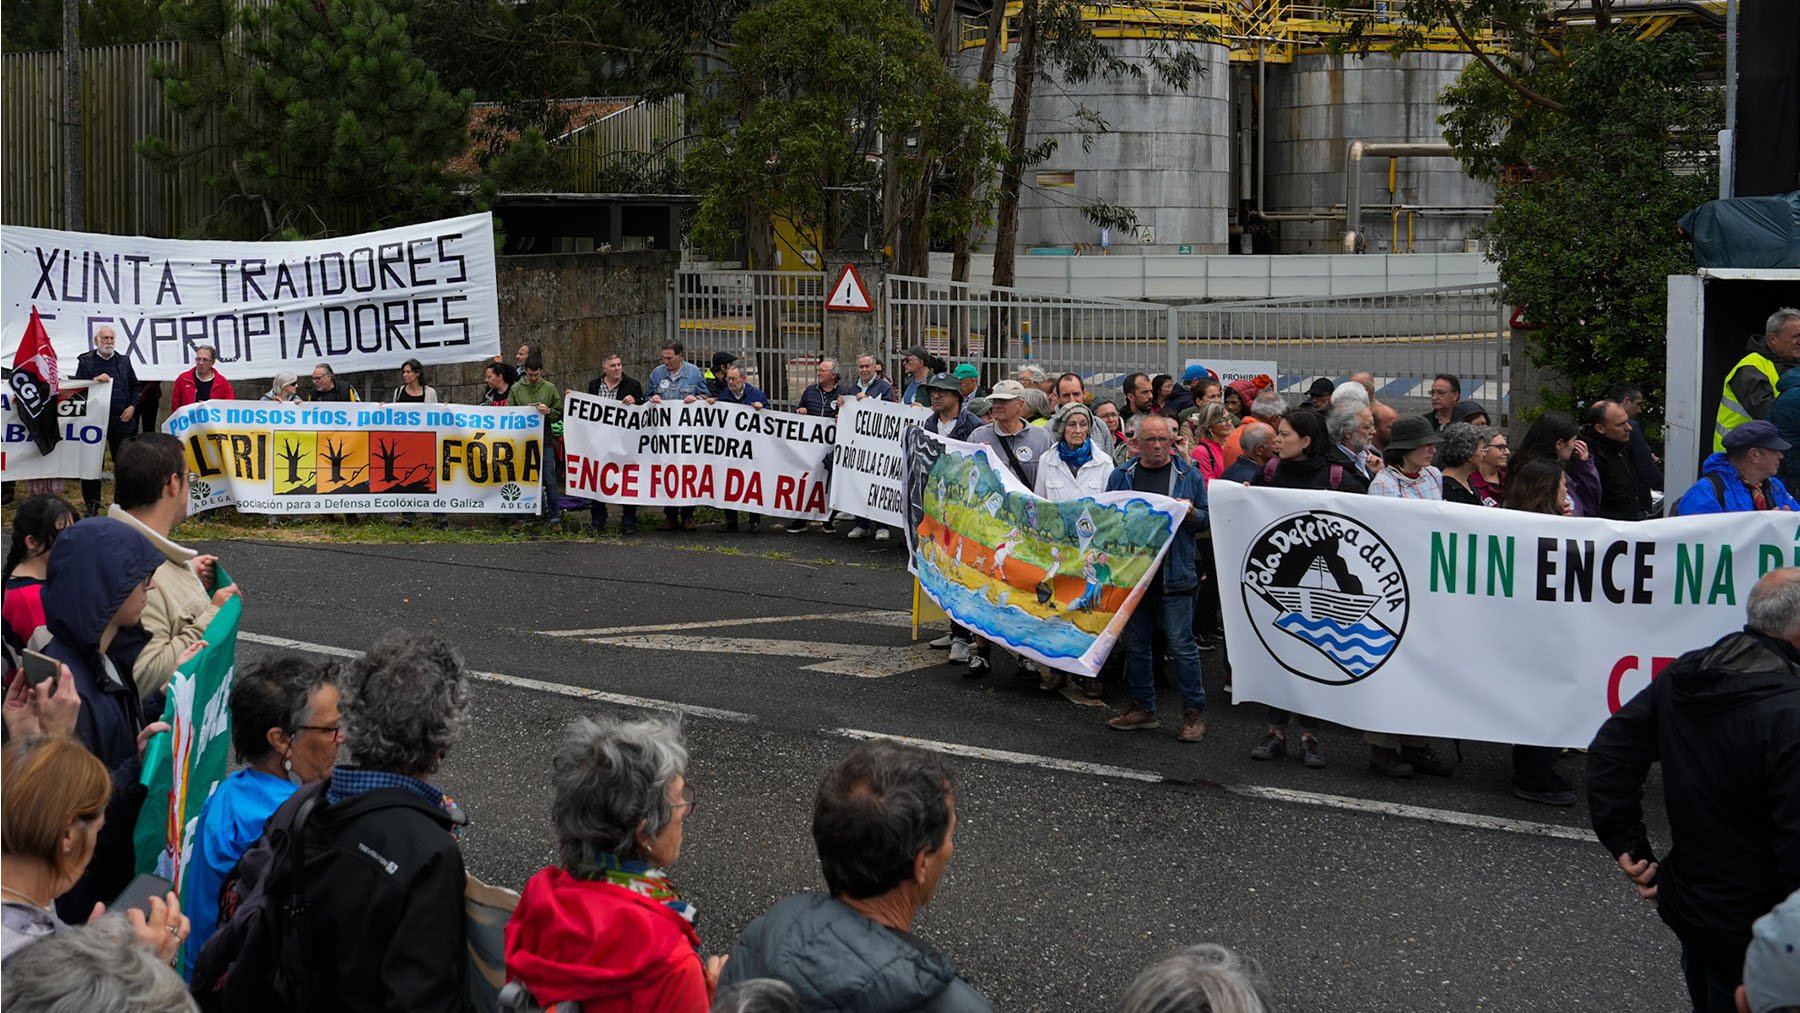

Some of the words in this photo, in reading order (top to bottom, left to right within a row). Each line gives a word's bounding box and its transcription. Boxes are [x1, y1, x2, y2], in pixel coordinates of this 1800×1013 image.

[31, 247, 182, 305] XUNTA
[1222, 373, 1258, 381] PROHIB
[57, 400, 86, 416] GT
[169, 408, 221, 436] Polos
[227, 408, 296, 424] nosos
[302, 407, 352, 426] ríos,
[357, 408, 421, 427] polas
[427, 411, 495, 430] nosas
[500, 411, 540, 430] rías
[678, 407, 729, 428] AAVV
[735, 411, 837, 445] CASTELAO
[855, 409, 901, 441] CELULOSA
[189, 434, 267, 481] LTRI
[442, 432, 541, 483] FÓRA
[638, 434, 753, 460] PONTEVEDRA
[842, 440, 856, 469] RÍO
[856, 448, 877, 474] ULLA
[876, 453, 884, 476] E
[883, 455, 890, 477] O
[889, 456, 903, 480] MA
[567, 454, 640, 497] ENCE
[650, 463, 715, 499] FORA
[724, 467, 764, 506] DA
[774, 472, 826, 514] RÍA
[868, 483, 880, 507] EN
[193, 495, 232, 510] ADEGA
[237, 499, 283, 510] sociación
[286, 500, 310, 511] para
[314, 501, 321, 509] a
[324, 499, 371, 509] Defensa
[374, 498, 430, 509] Ecolóxica
[433, 499, 447, 509] de
[450, 498, 485, 509] Galiza
[500, 502, 538, 510] ADEGA
[1245, 553, 1282, 594] Pola
[1268, 518, 1360, 553] Defensa
[1359, 543, 1387, 573] da
[1378, 571, 1405, 613] RIA
[1430, 531, 1515, 598] NIN
[1536, 536, 1656, 604] ENCE
[1674, 543, 1737, 605] NA
